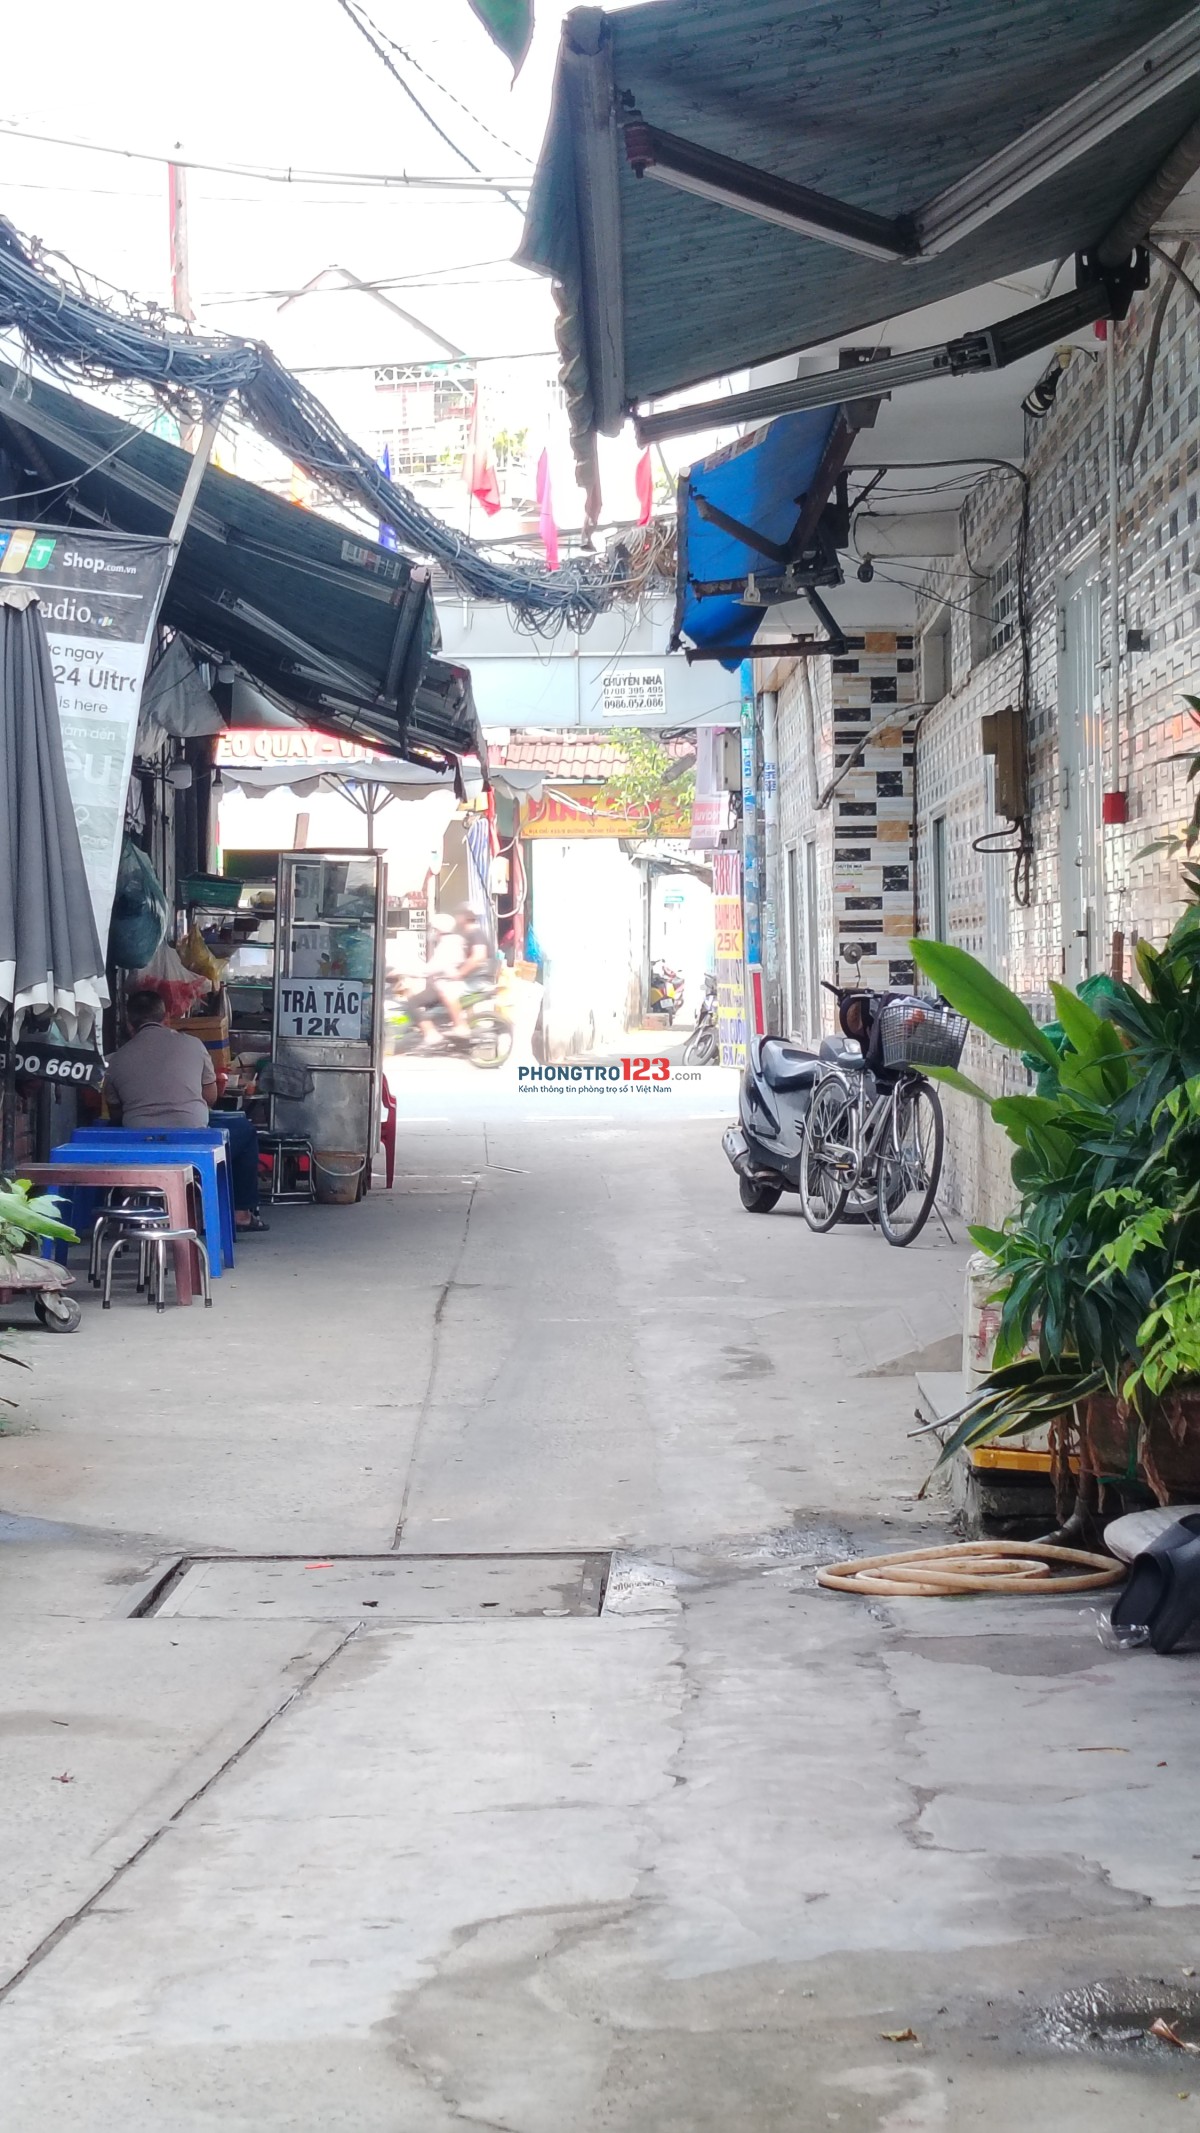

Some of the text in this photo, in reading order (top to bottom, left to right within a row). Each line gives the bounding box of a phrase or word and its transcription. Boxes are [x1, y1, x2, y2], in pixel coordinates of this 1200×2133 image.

[63, 552, 137, 574] Shop.com.vn
[41, 597, 92, 623] udio
[64, 647, 104, 664] ngay
[54, 665, 81, 686] 24
[74, 698, 108, 713] here
[220, 734, 250, 758] EO
[254, 731, 317, 761] QUAY
[717, 933, 739, 951] 25K
[282, 983, 359, 1014] TRÀ TẮC
[292, 1017, 340, 1037] 12K
[46, 1059, 93, 1080] 6601
